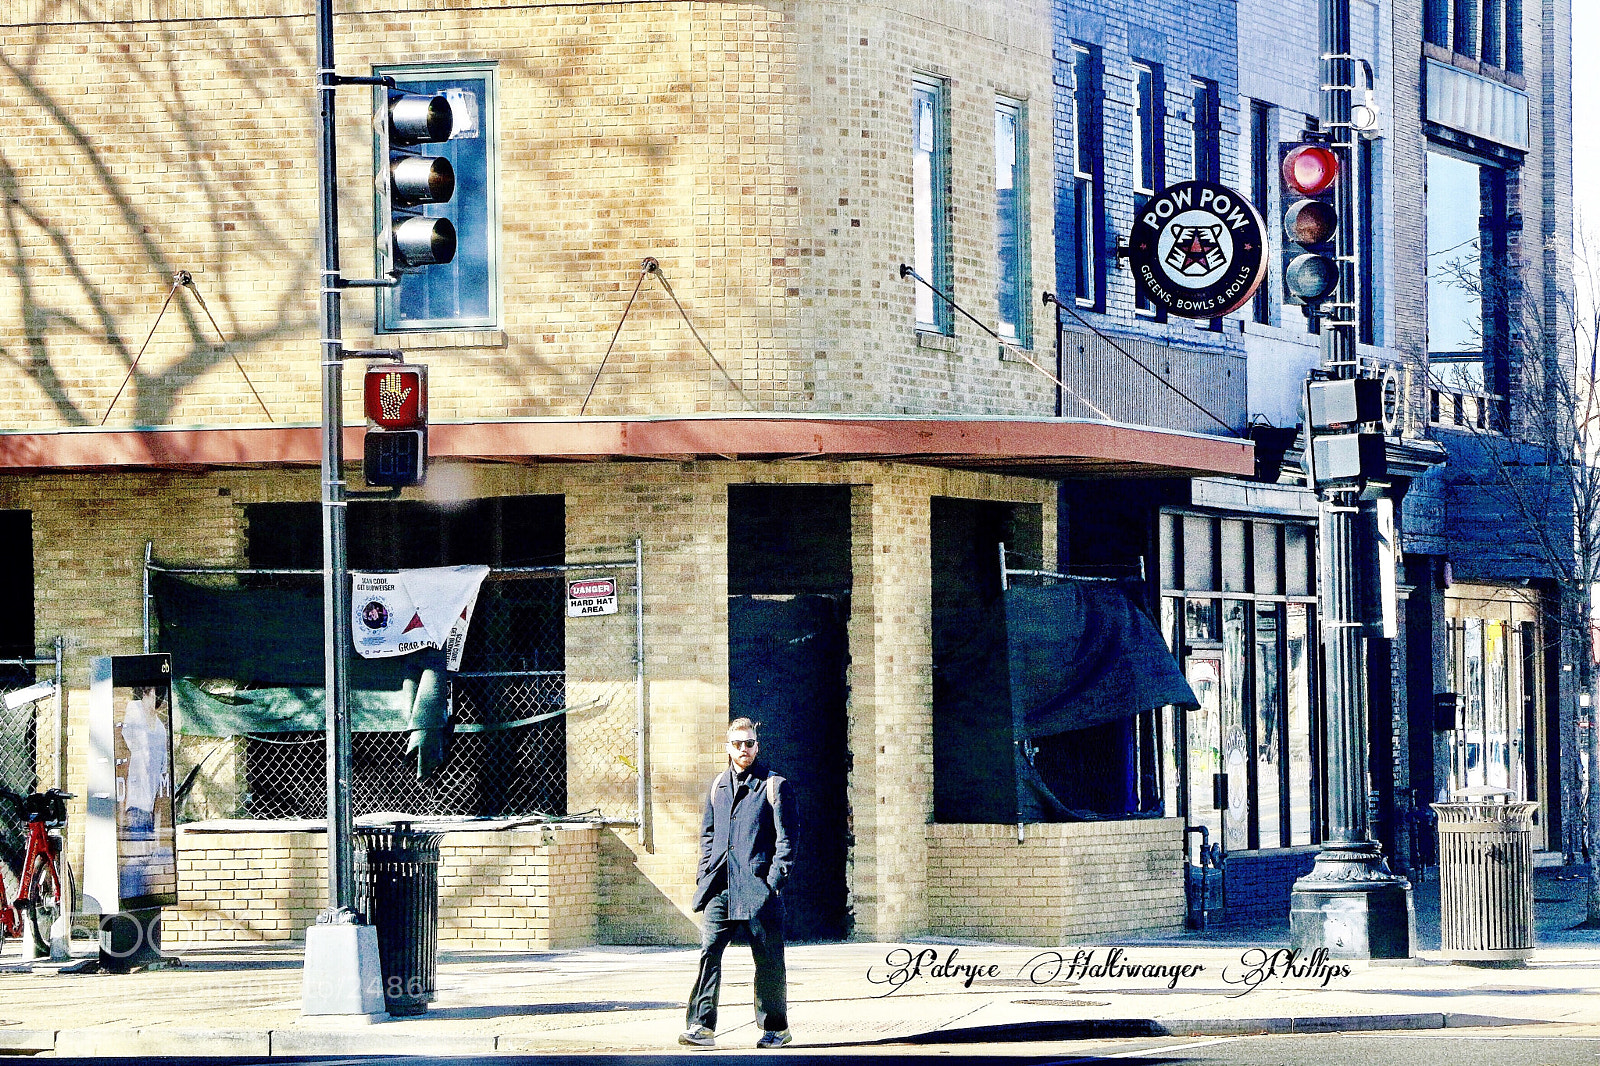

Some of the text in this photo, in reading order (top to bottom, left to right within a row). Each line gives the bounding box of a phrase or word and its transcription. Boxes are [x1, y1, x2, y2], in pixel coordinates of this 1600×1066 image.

[1143, 187, 1250, 230] POW POW
[1141, 264, 1251, 310] GREENS, BOWLS & ROLLS
[366, 584, 395, 592] BUDWEISER
[573, 584, 611, 595] DANGER
[571, 597, 614, 607] HARD HAT
[581, 606, 604, 614] AREA
